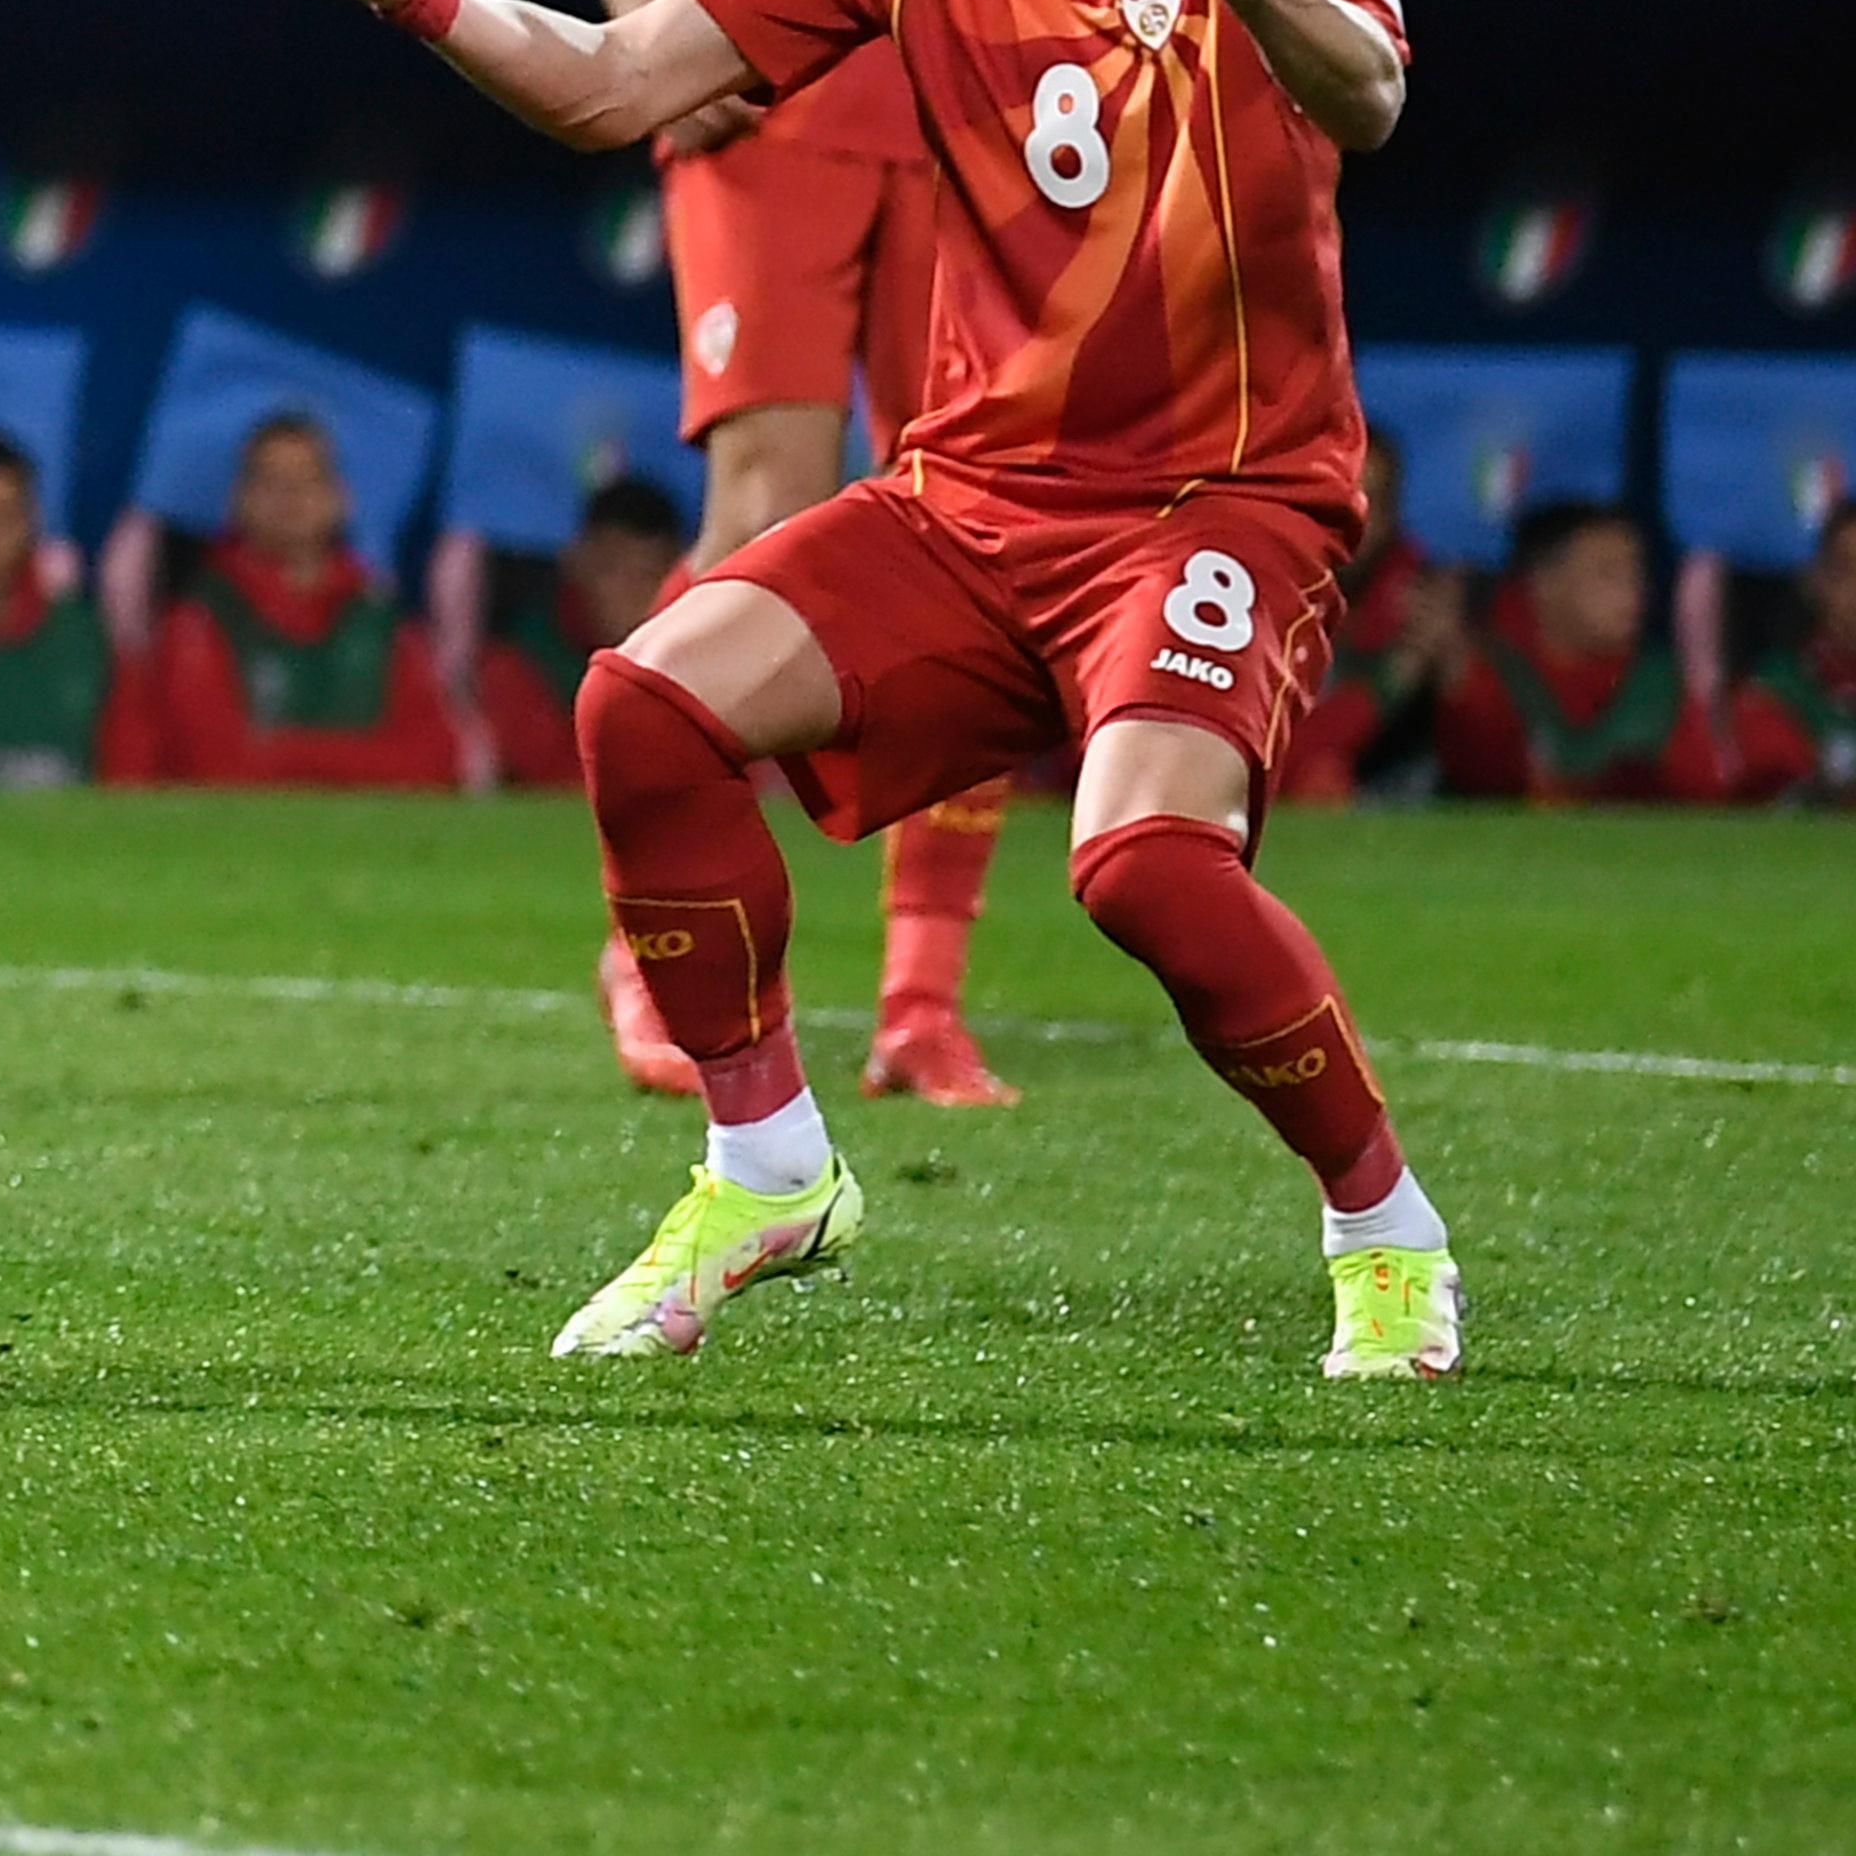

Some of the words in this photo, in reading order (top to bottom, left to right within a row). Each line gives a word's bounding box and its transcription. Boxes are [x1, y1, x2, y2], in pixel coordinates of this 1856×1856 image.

[1024, 63, 1111, 209] 8
[1163, 549, 1256, 653] 8
[1150, 647, 1234, 691] JAKO
[628, 929, 696, 961] KO
